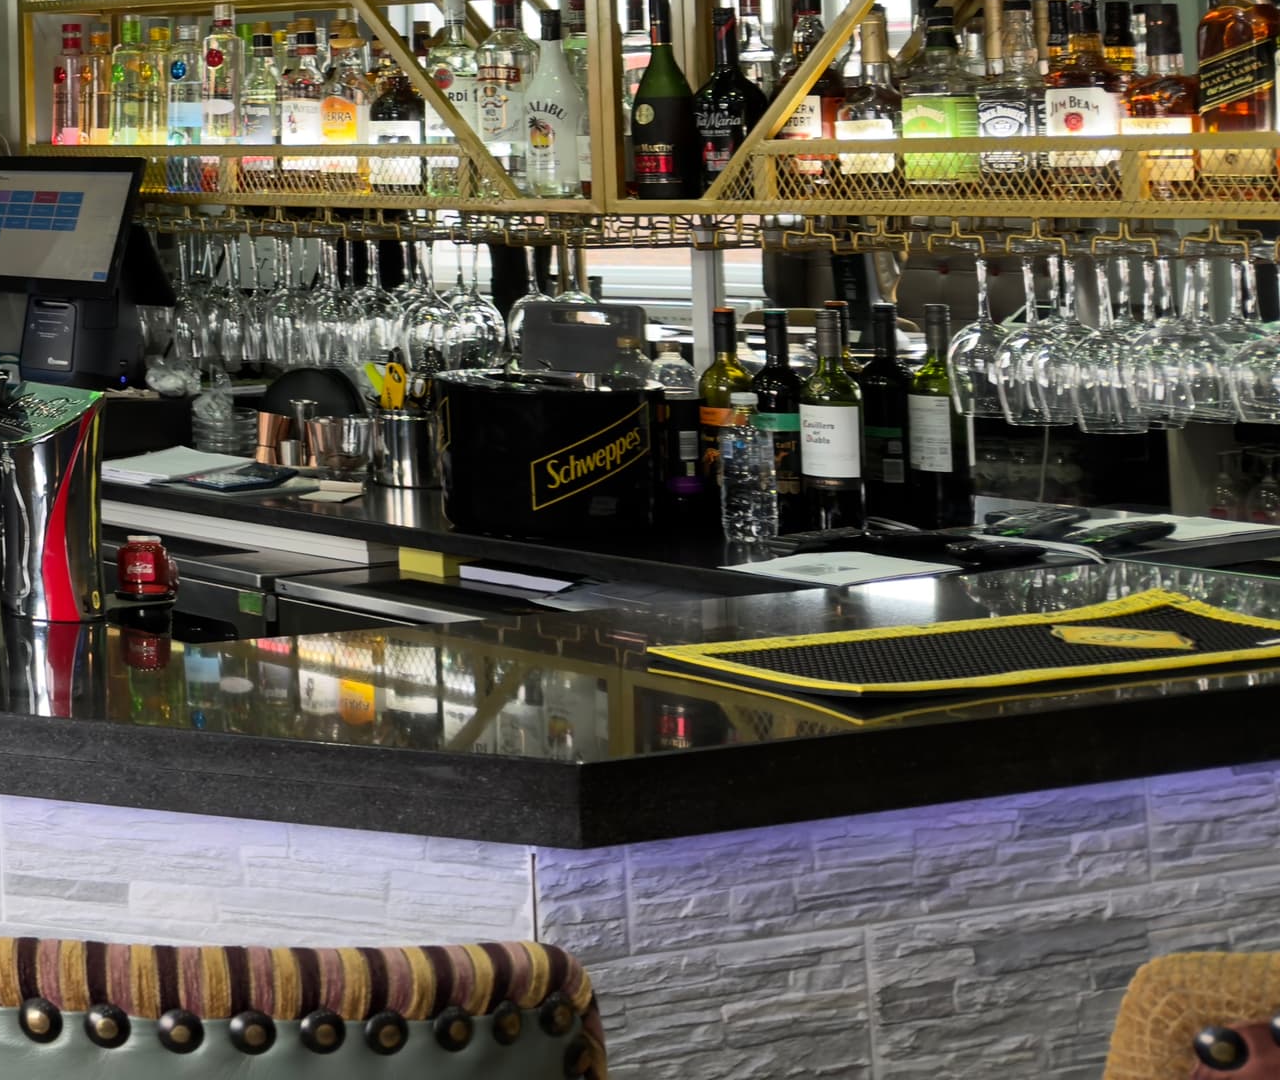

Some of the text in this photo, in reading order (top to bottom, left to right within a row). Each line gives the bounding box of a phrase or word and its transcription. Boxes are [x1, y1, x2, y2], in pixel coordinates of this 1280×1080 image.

[1200, 61, 1263, 90] BLACK LABEL
[1050, 100, 1067, 117] JIM
[1068, 95, 1100, 115] BEAM
[709, 111, 741, 128] Maria
[806, 434, 832, 444] Diablo
[546, 426, 641, 489] Schweppes
